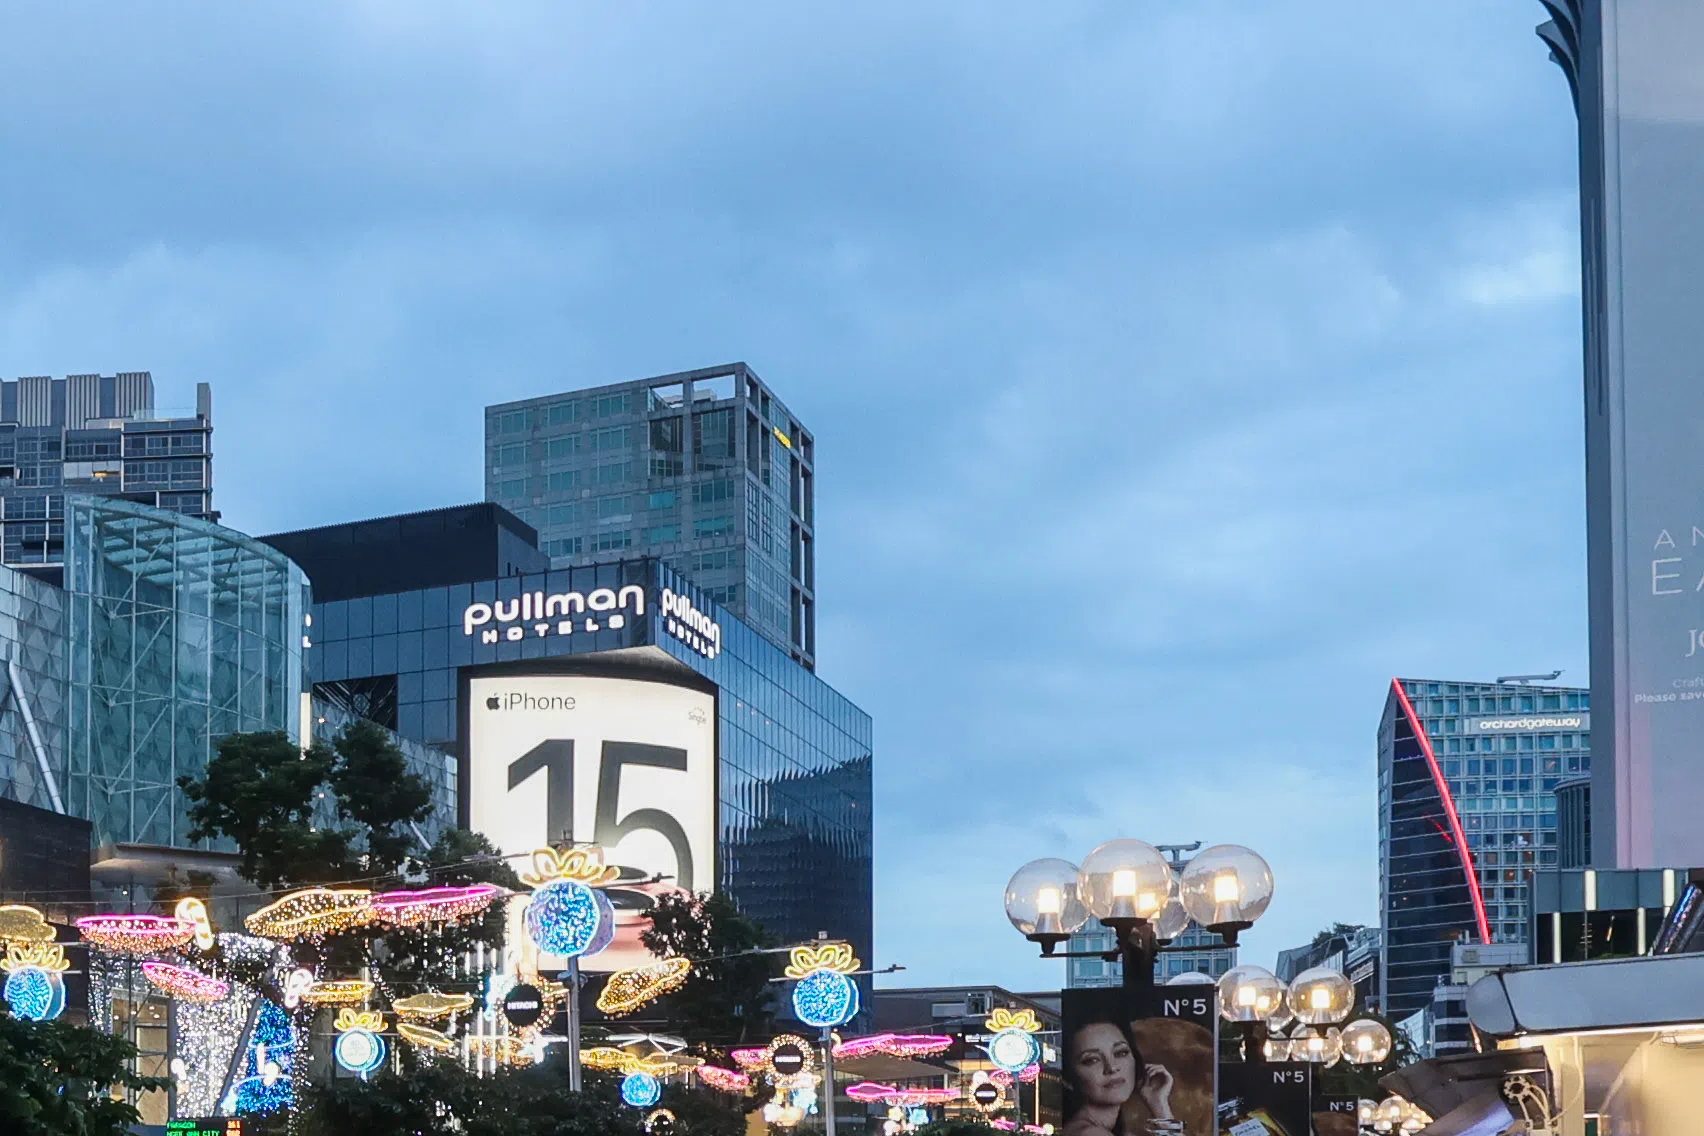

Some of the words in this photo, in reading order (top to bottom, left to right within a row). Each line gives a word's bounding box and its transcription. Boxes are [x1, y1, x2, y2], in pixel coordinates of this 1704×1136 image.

[464, 585, 644, 636] pullman
[662, 588, 720, 654] pullman
[482, 614, 625, 645] HOTELS
[669, 620, 716, 660] HOTELS
[504, 692, 577, 711] iPhone
[1634, 691, 1677, 704] Please
[1479, 717, 1581, 730] orchardgateway
[508, 739, 694, 893] 15
